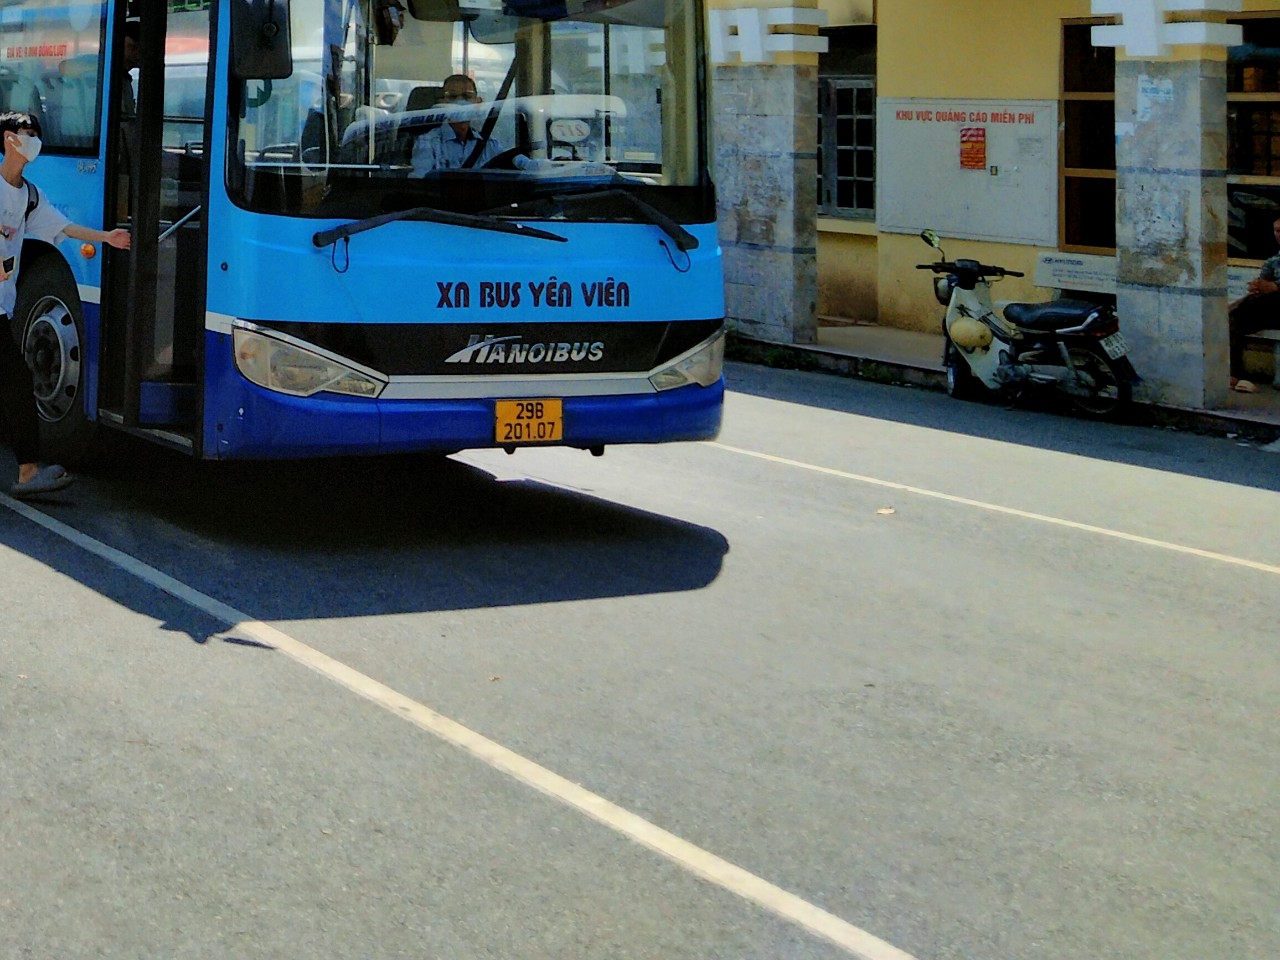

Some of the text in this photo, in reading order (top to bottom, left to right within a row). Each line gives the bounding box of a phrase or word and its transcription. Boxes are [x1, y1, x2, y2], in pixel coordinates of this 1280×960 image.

[896, 110, 913, 121] KHU
[436, 276, 630, 308] XN BUS YÊN VIÊN
[444, 334, 605, 364] HANOIBUS
[515, 402, 544, 420] 29B
[504, 422, 556, 440] 201.07
